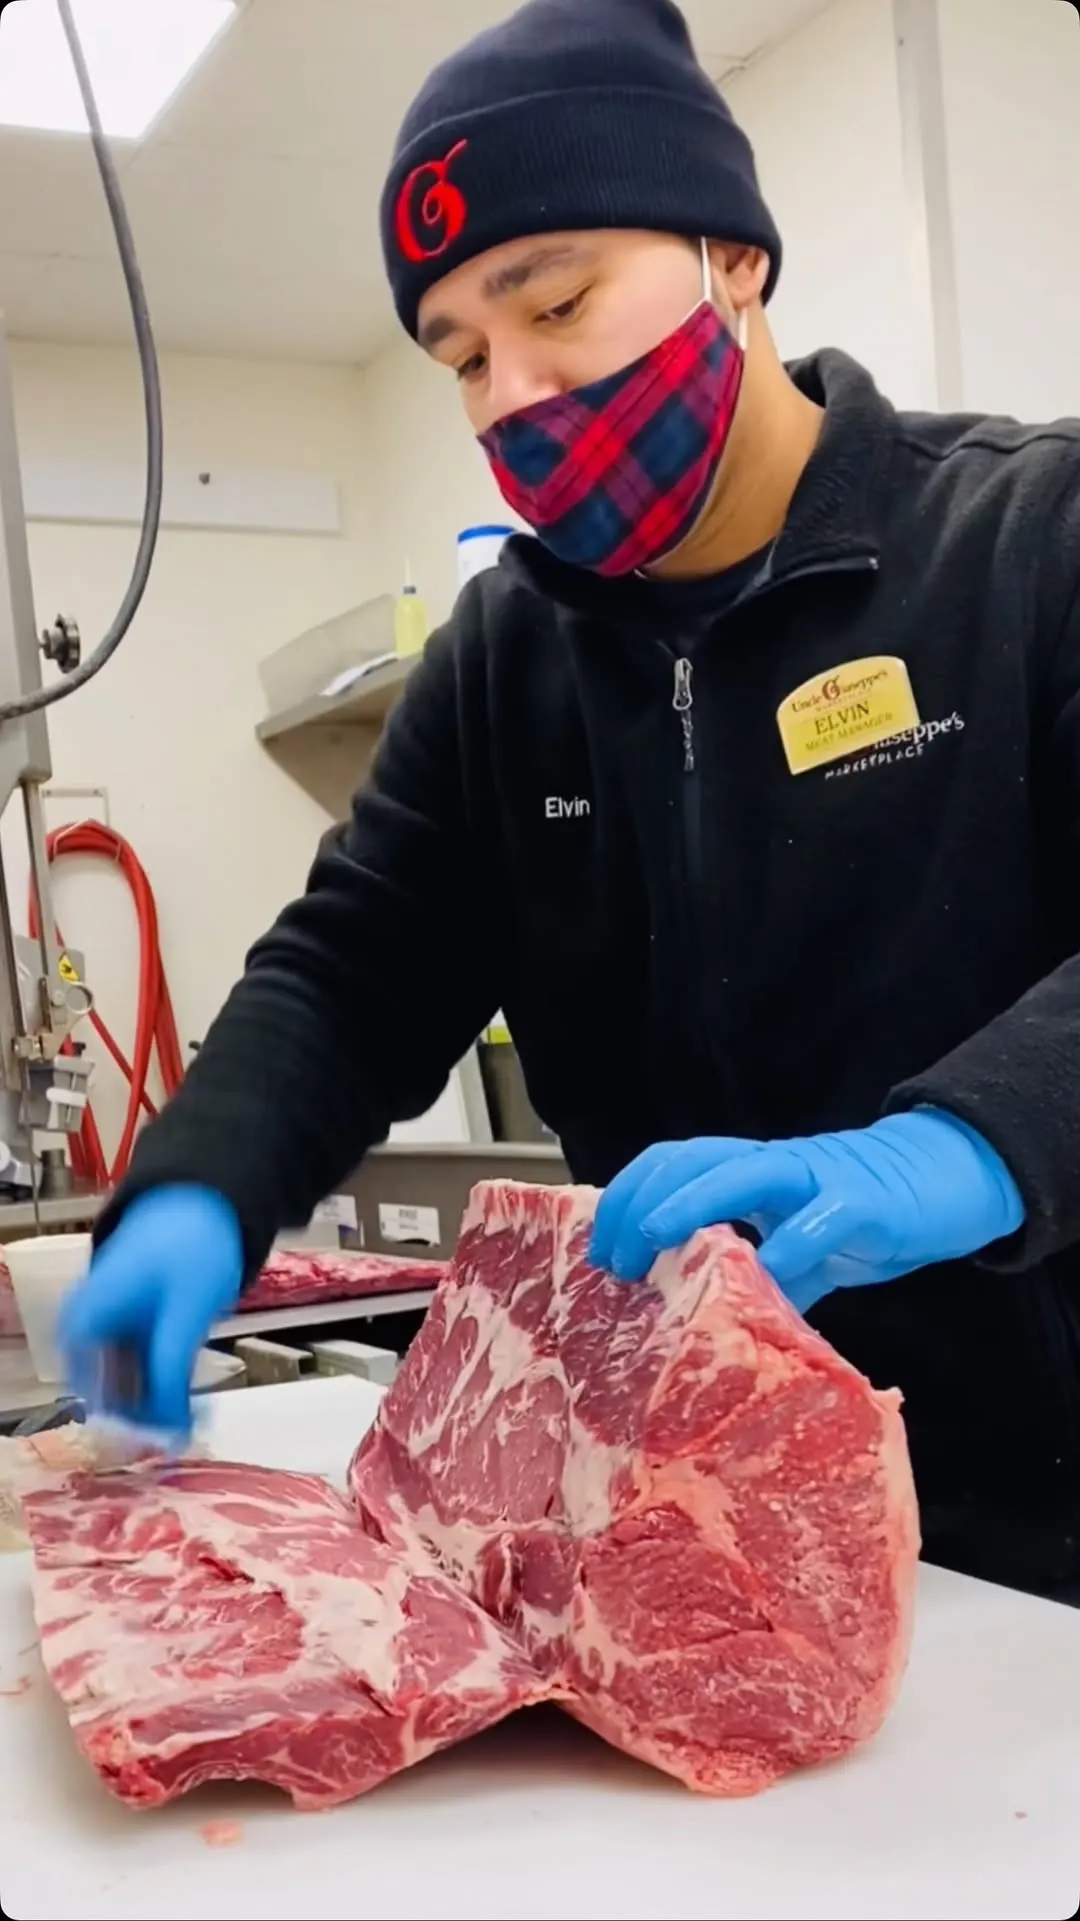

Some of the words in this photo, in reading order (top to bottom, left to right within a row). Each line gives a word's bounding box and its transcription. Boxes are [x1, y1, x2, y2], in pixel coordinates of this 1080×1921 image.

[792, 694, 822, 713] Uncle
[815, 700, 870, 735] ELVIN
[824, 742, 926, 781] MARKETPLACE
[545, 795, 591, 818] Elvin
